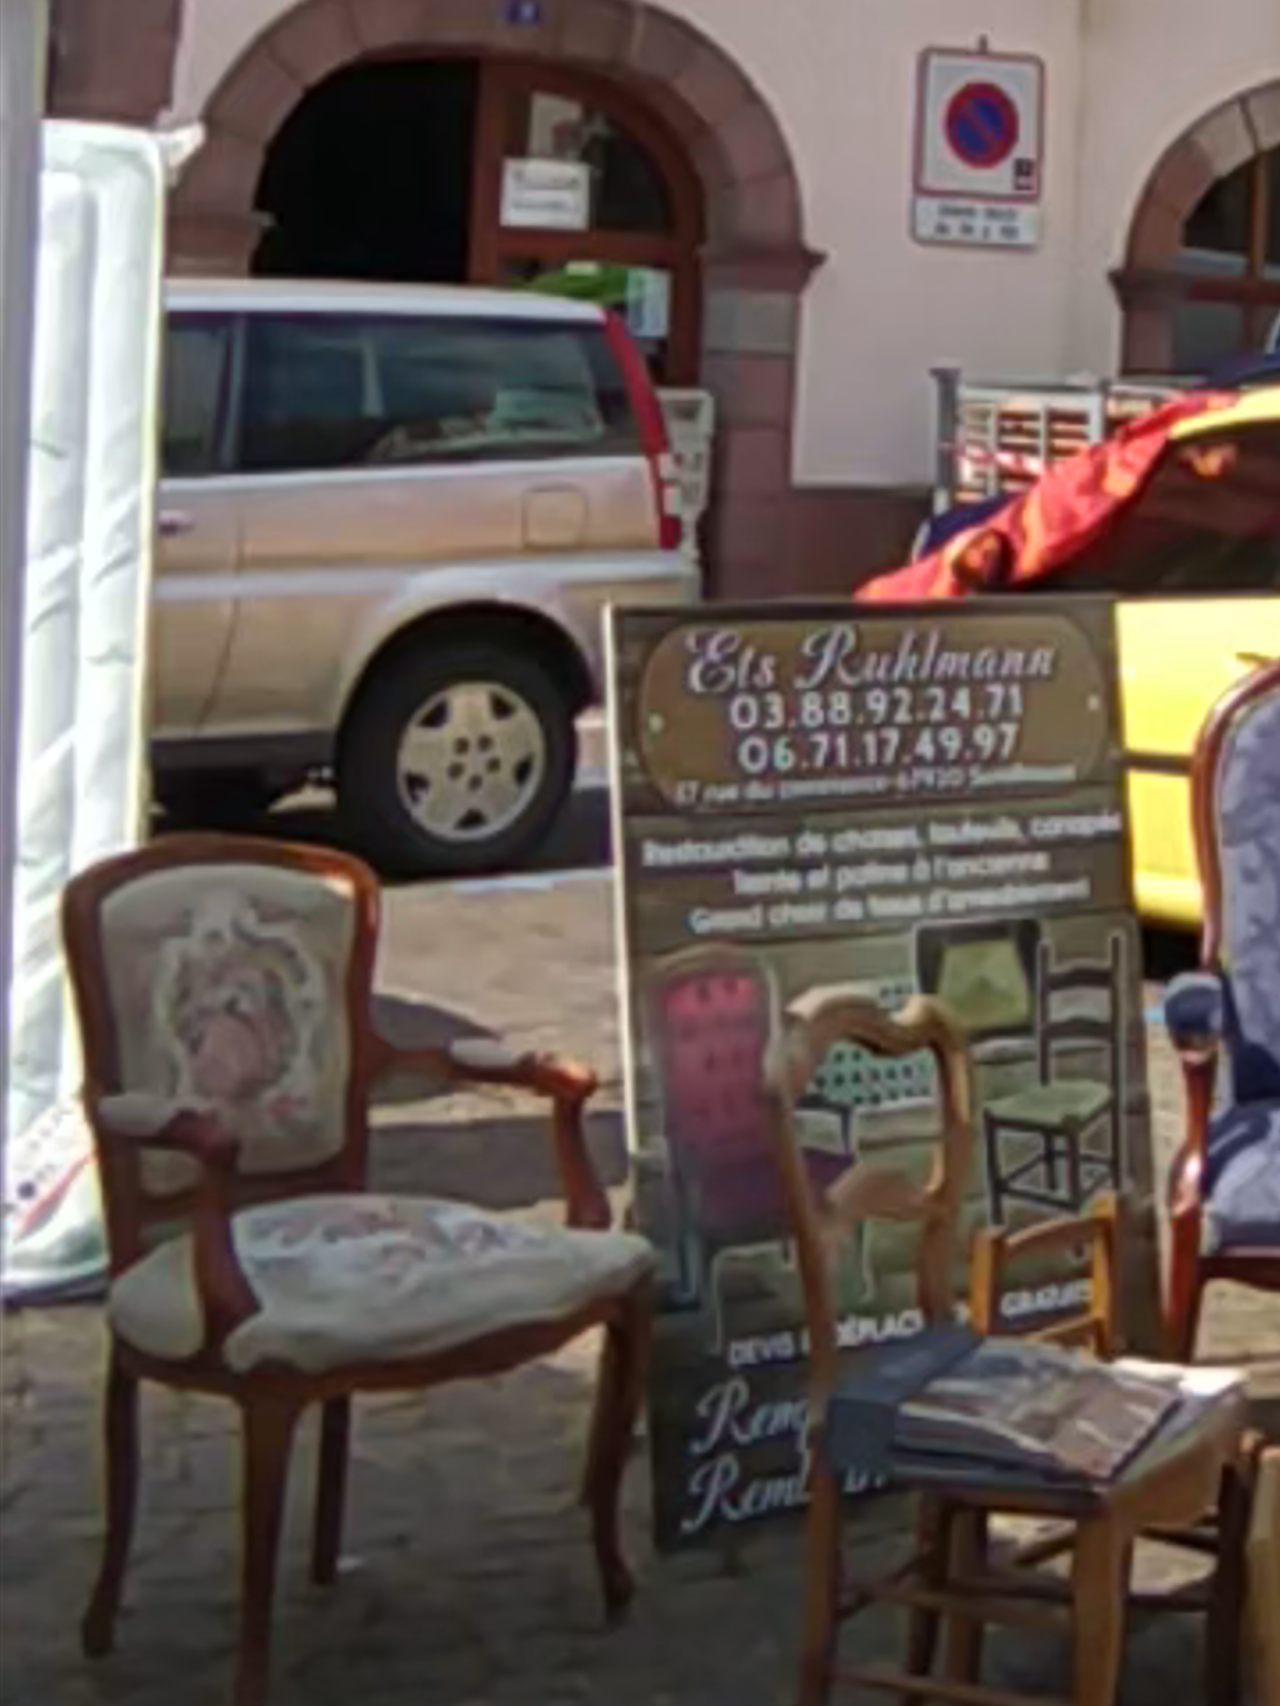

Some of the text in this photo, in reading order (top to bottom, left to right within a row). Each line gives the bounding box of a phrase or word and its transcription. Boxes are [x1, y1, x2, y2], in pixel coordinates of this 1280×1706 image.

[686, 625, 1055, 693] Ets Ruhlmann
[730, 684, 1023, 729] 03.88.92.24.71
[738, 723, 1019, 772] 06.71.17.49.97
[795, 830, 827, 856] de
[728, 1332, 795, 1366] DEVIS
